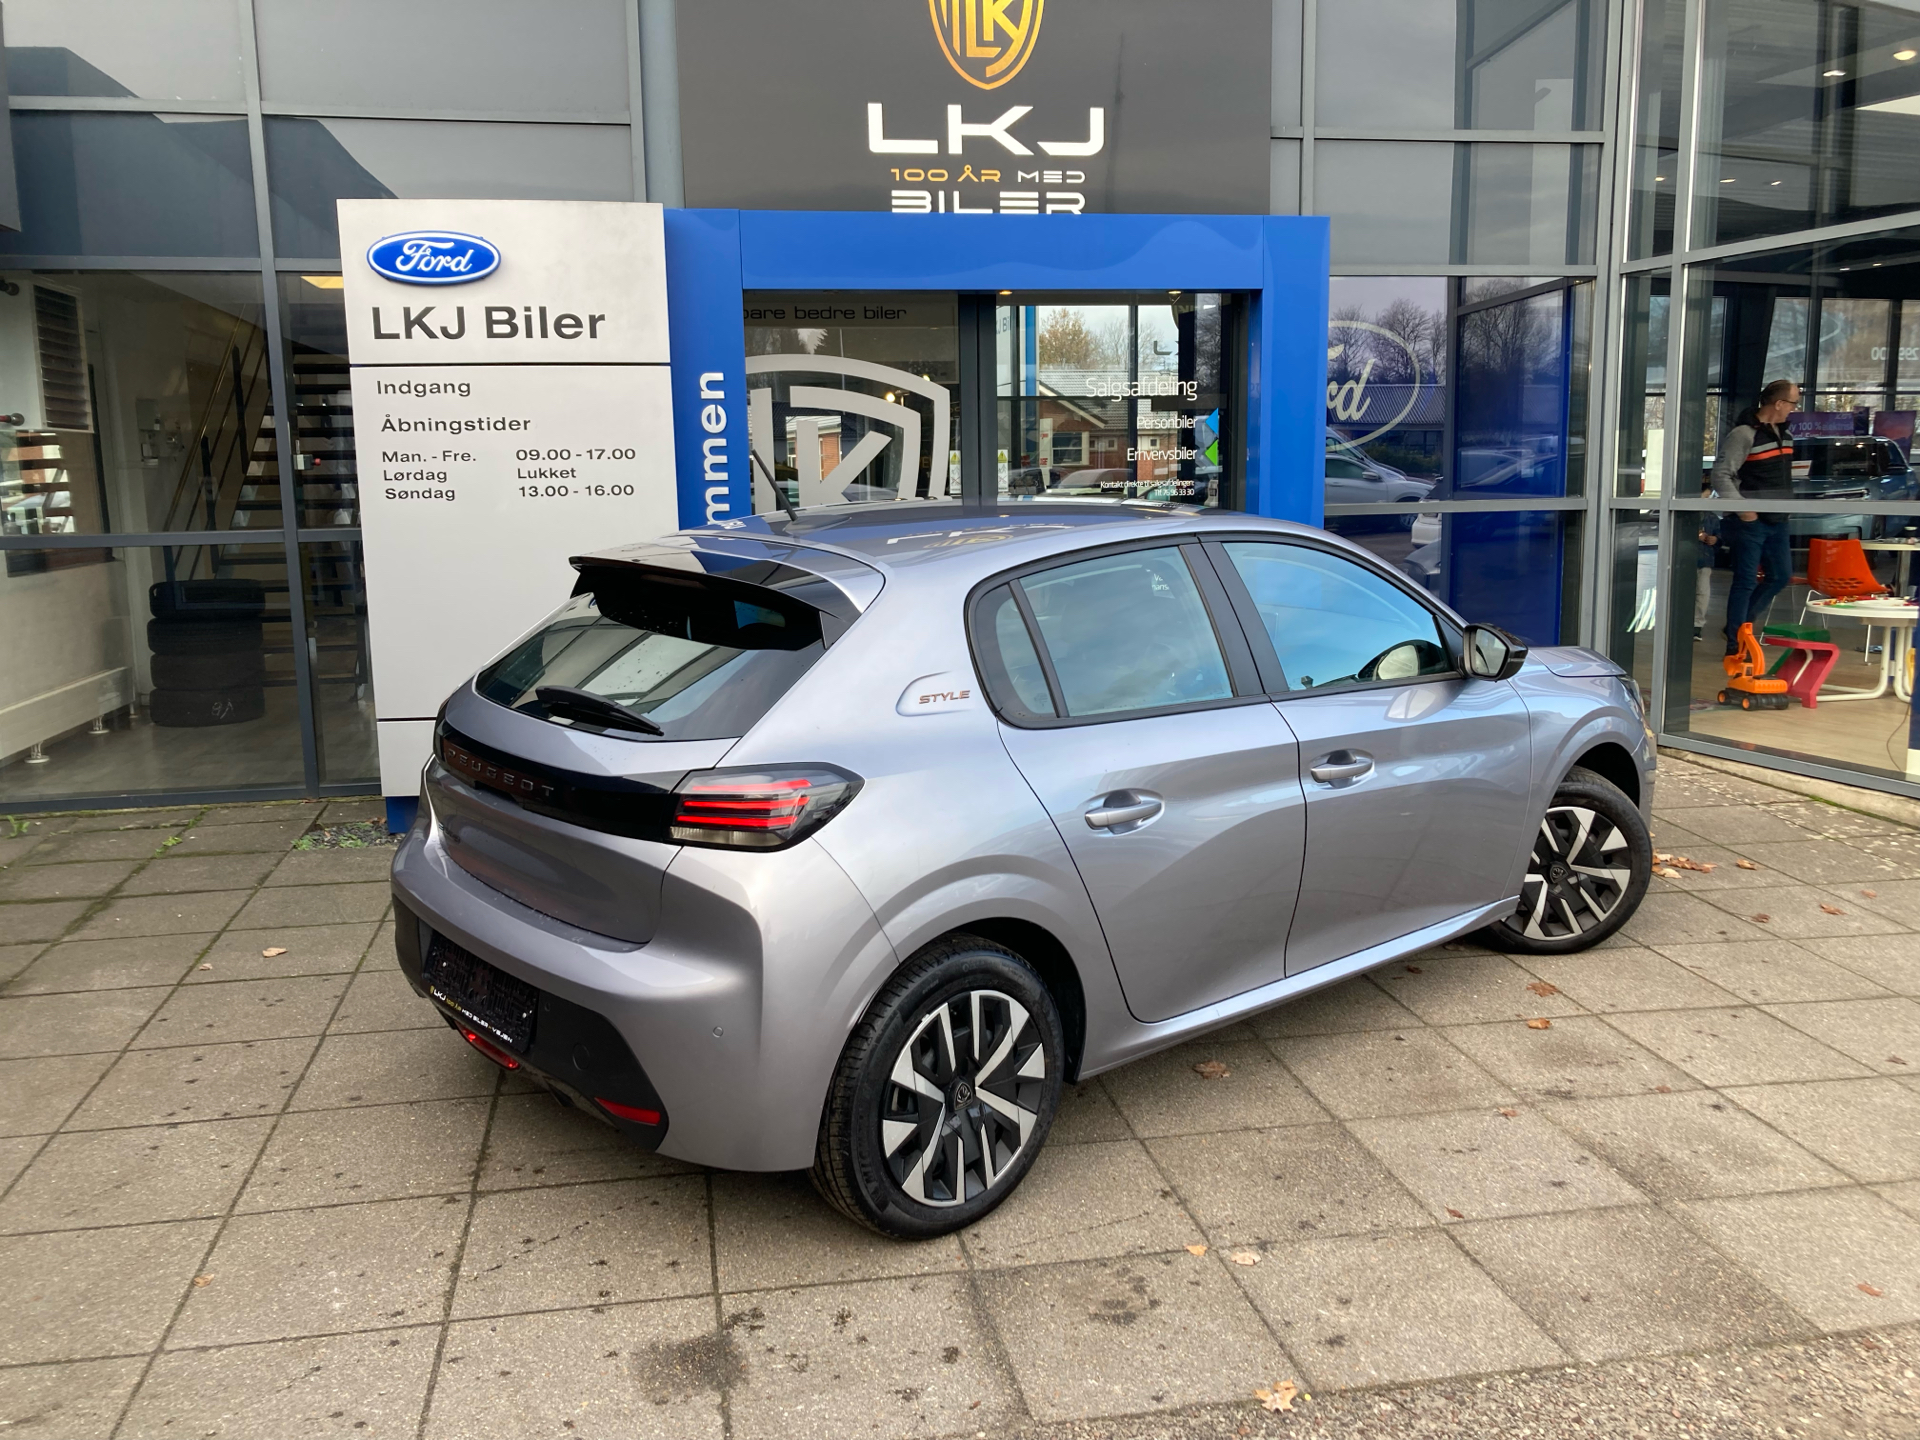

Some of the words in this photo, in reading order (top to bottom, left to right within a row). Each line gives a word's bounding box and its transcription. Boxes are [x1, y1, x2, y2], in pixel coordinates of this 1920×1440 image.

[867, 102, 1105, 156] LKJ
[891, 168, 949, 182] 100
[957, 164, 1001, 182] ÅR
[1017, 170, 1086, 184] MED
[891, 190, 1086, 214] BILER
[394, 239, 474, 272] Ford
[794, 306, 856, 320] bedre
[863, 306, 907, 320] biler
[372, 306, 466, 340] LKJ
[485, 306, 606, 339] Biler
[376, 380, 471, 397] Indgang
[1086, 377, 1198, 401] Salgsafdeling
[381, 413, 531, 435] Åbningstider
[1137, 415, 1197, 429] Personbiler
[1799, 422, 1813, 430] 100
[382, 450, 428, 463] Man.
[442, 450, 477, 463] Fre.
[515, 448, 571, 461] 09.00
[586, 448, 636, 461] 17.00
[1127, 446, 1197, 461] Erhvervsbiler
[383, 469, 447, 483] Lørdag
[517, 467, 577, 480] Lukket
[385, 487, 456, 501] Søndag
[518, 484, 569, 497] 13.00
[584, 484, 635, 496] 16.00
[919, 690, 971, 704] STYLE
[447, 748, 554, 797] PEUGEOT
